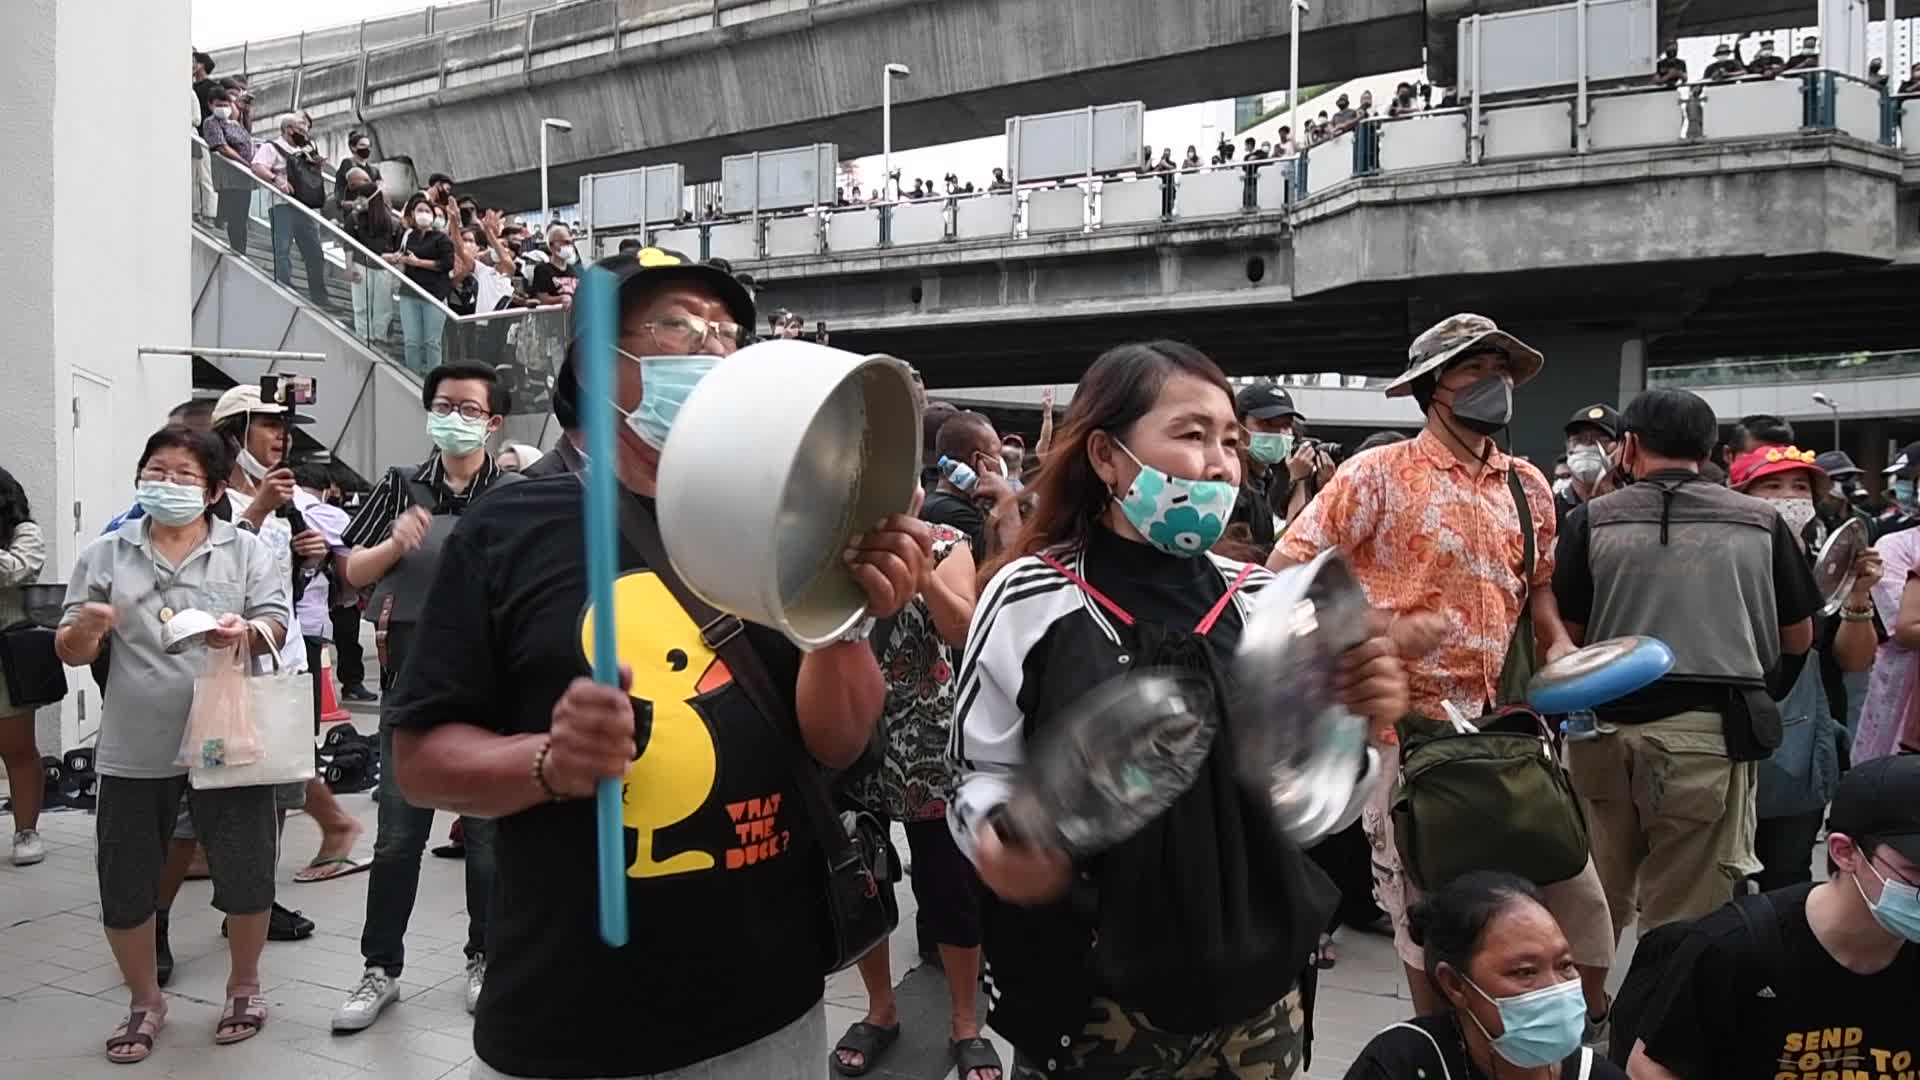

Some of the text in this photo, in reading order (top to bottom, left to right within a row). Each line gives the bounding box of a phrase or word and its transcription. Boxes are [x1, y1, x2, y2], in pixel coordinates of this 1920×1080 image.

[725, 792, 781, 823] WHAT
[735, 816, 775, 844] THE
[1783, 1026, 1864, 1052] SEND
[1870, 1047, 1912, 1073] TO
